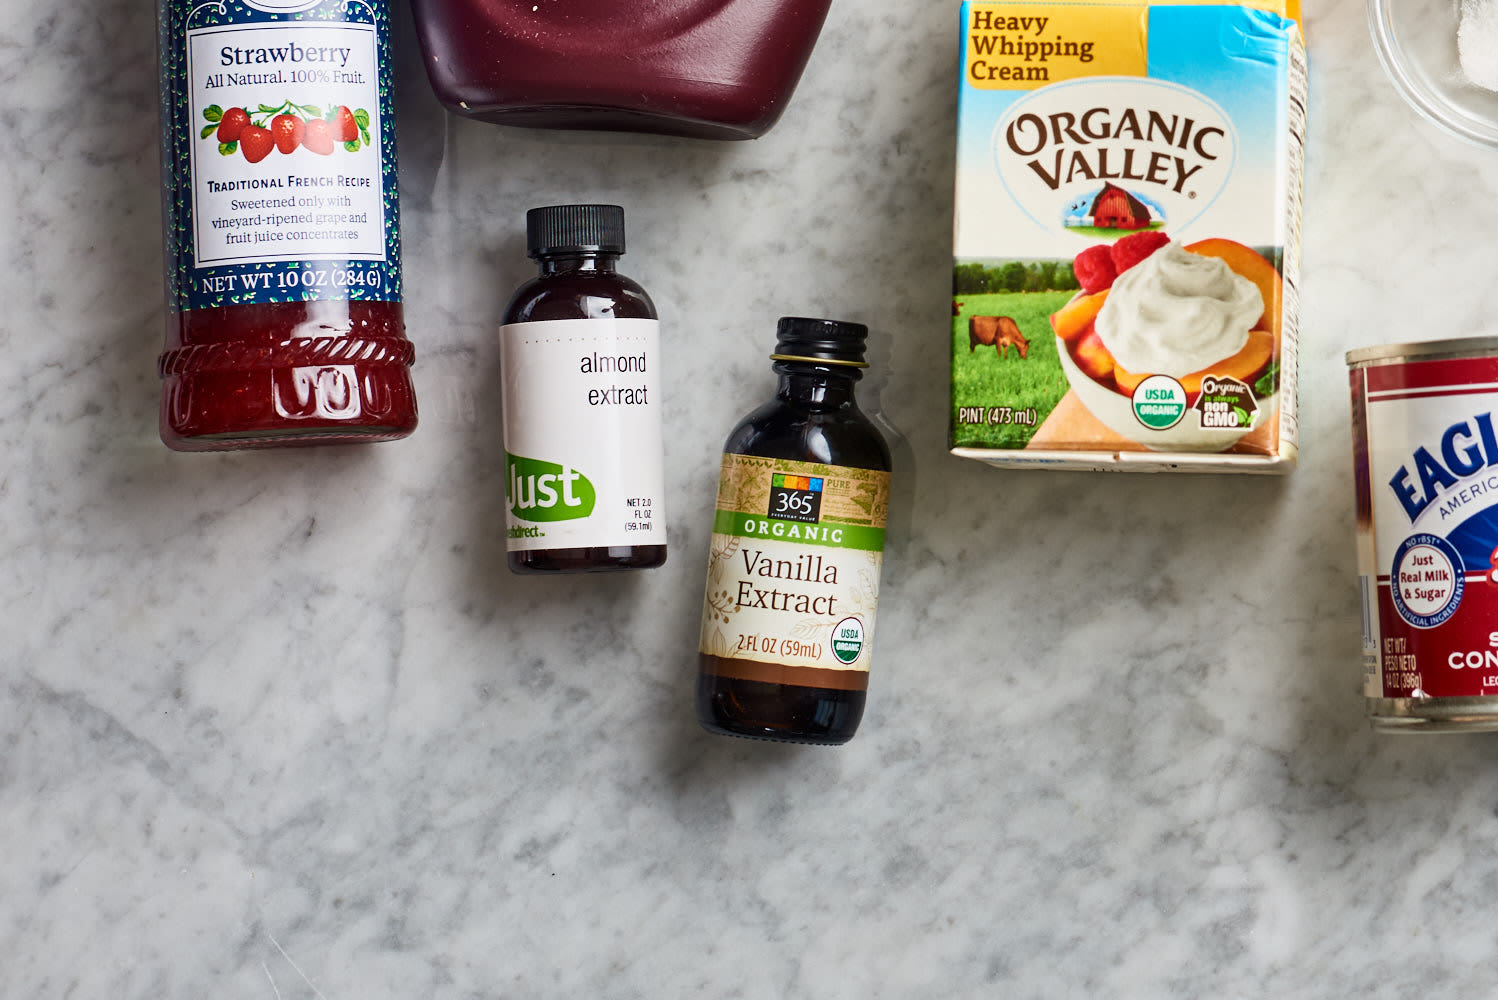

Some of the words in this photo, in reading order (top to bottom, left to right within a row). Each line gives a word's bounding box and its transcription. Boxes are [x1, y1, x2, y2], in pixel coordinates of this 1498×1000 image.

[972, 10, 1049, 35] Heavy
[220, 42, 351, 67] Strawberry
[971, 36, 1094, 62] Whipping
[205, 74, 223, 89] All
[227, 70, 287, 87] Natural.
[291, 70, 330, 83] 100%
[333, 71, 366, 84] Fruit.
[971, 60, 1050, 81] Cream
[1006, 107, 1225, 161] ORGANIC
[1027, 148, 1203, 194] VALLEY
[207, 178, 284, 193] TRADITIONAL
[288, 176, 333, 187] FRENCH
[337, 175, 371, 187] RECIPE
[231, 196, 295, 211] Sweetened
[298, 196, 325, 209] only
[324, 196, 351, 207] with
[211, 212, 313, 229] vineyard-ripened
[316, 213, 347, 226] grape
[349, 212, 367, 224] and
[226, 232, 251, 244] fruit
[253, 230, 284, 244] juice
[286, 229, 359, 241] concentrates
[202, 275, 237, 294] NET
[240, 272, 273, 290] WT
[277, 270, 299, 288] 10
[301, 270, 328, 287] OZ
[580, 350, 647, 374] almond
[587, 384, 648, 406] extract
[1145, 389, 1175, 400] USDA
[1203, 380, 1246, 396] Organic
[960, 407, 985, 423] PINT
[987, 407, 1012, 425] (473
[1014, 408, 1037, 425] mL)
[1140, 404, 1179, 416] ORGANIC
[1204, 402, 1229, 412] non
[1203, 411, 1239, 427] GMO
[506, 463, 581, 510] Just
[827, 479, 851, 489] PURE
[626, 498, 640, 507] NET
[642, 498, 652, 507] 2.0
[776, 491, 813, 514] 365
[624, 522, 653, 532] (59.1ml)
[744, 519, 843, 543] ORGANIC
[742, 549, 838, 584] Vanilla
[1412, 555, 1433, 566] Just
[1400, 571, 1421, 583] Real
[1424, 569, 1449, 581] Milk
[736, 580, 838, 616] Extract
[1404, 588, 1412, 599] &
[1415, 588, 1446, 602] Sugar
[840, 628, 859, 639] USDA
[737, 634, 745, 650] 2
[746, 635, 758, 652] FL
[761, 637, 777, 654] OZ
[780, 639, 822, 660] (59mL)
[835, 641, 860, 652] ORGANIC
